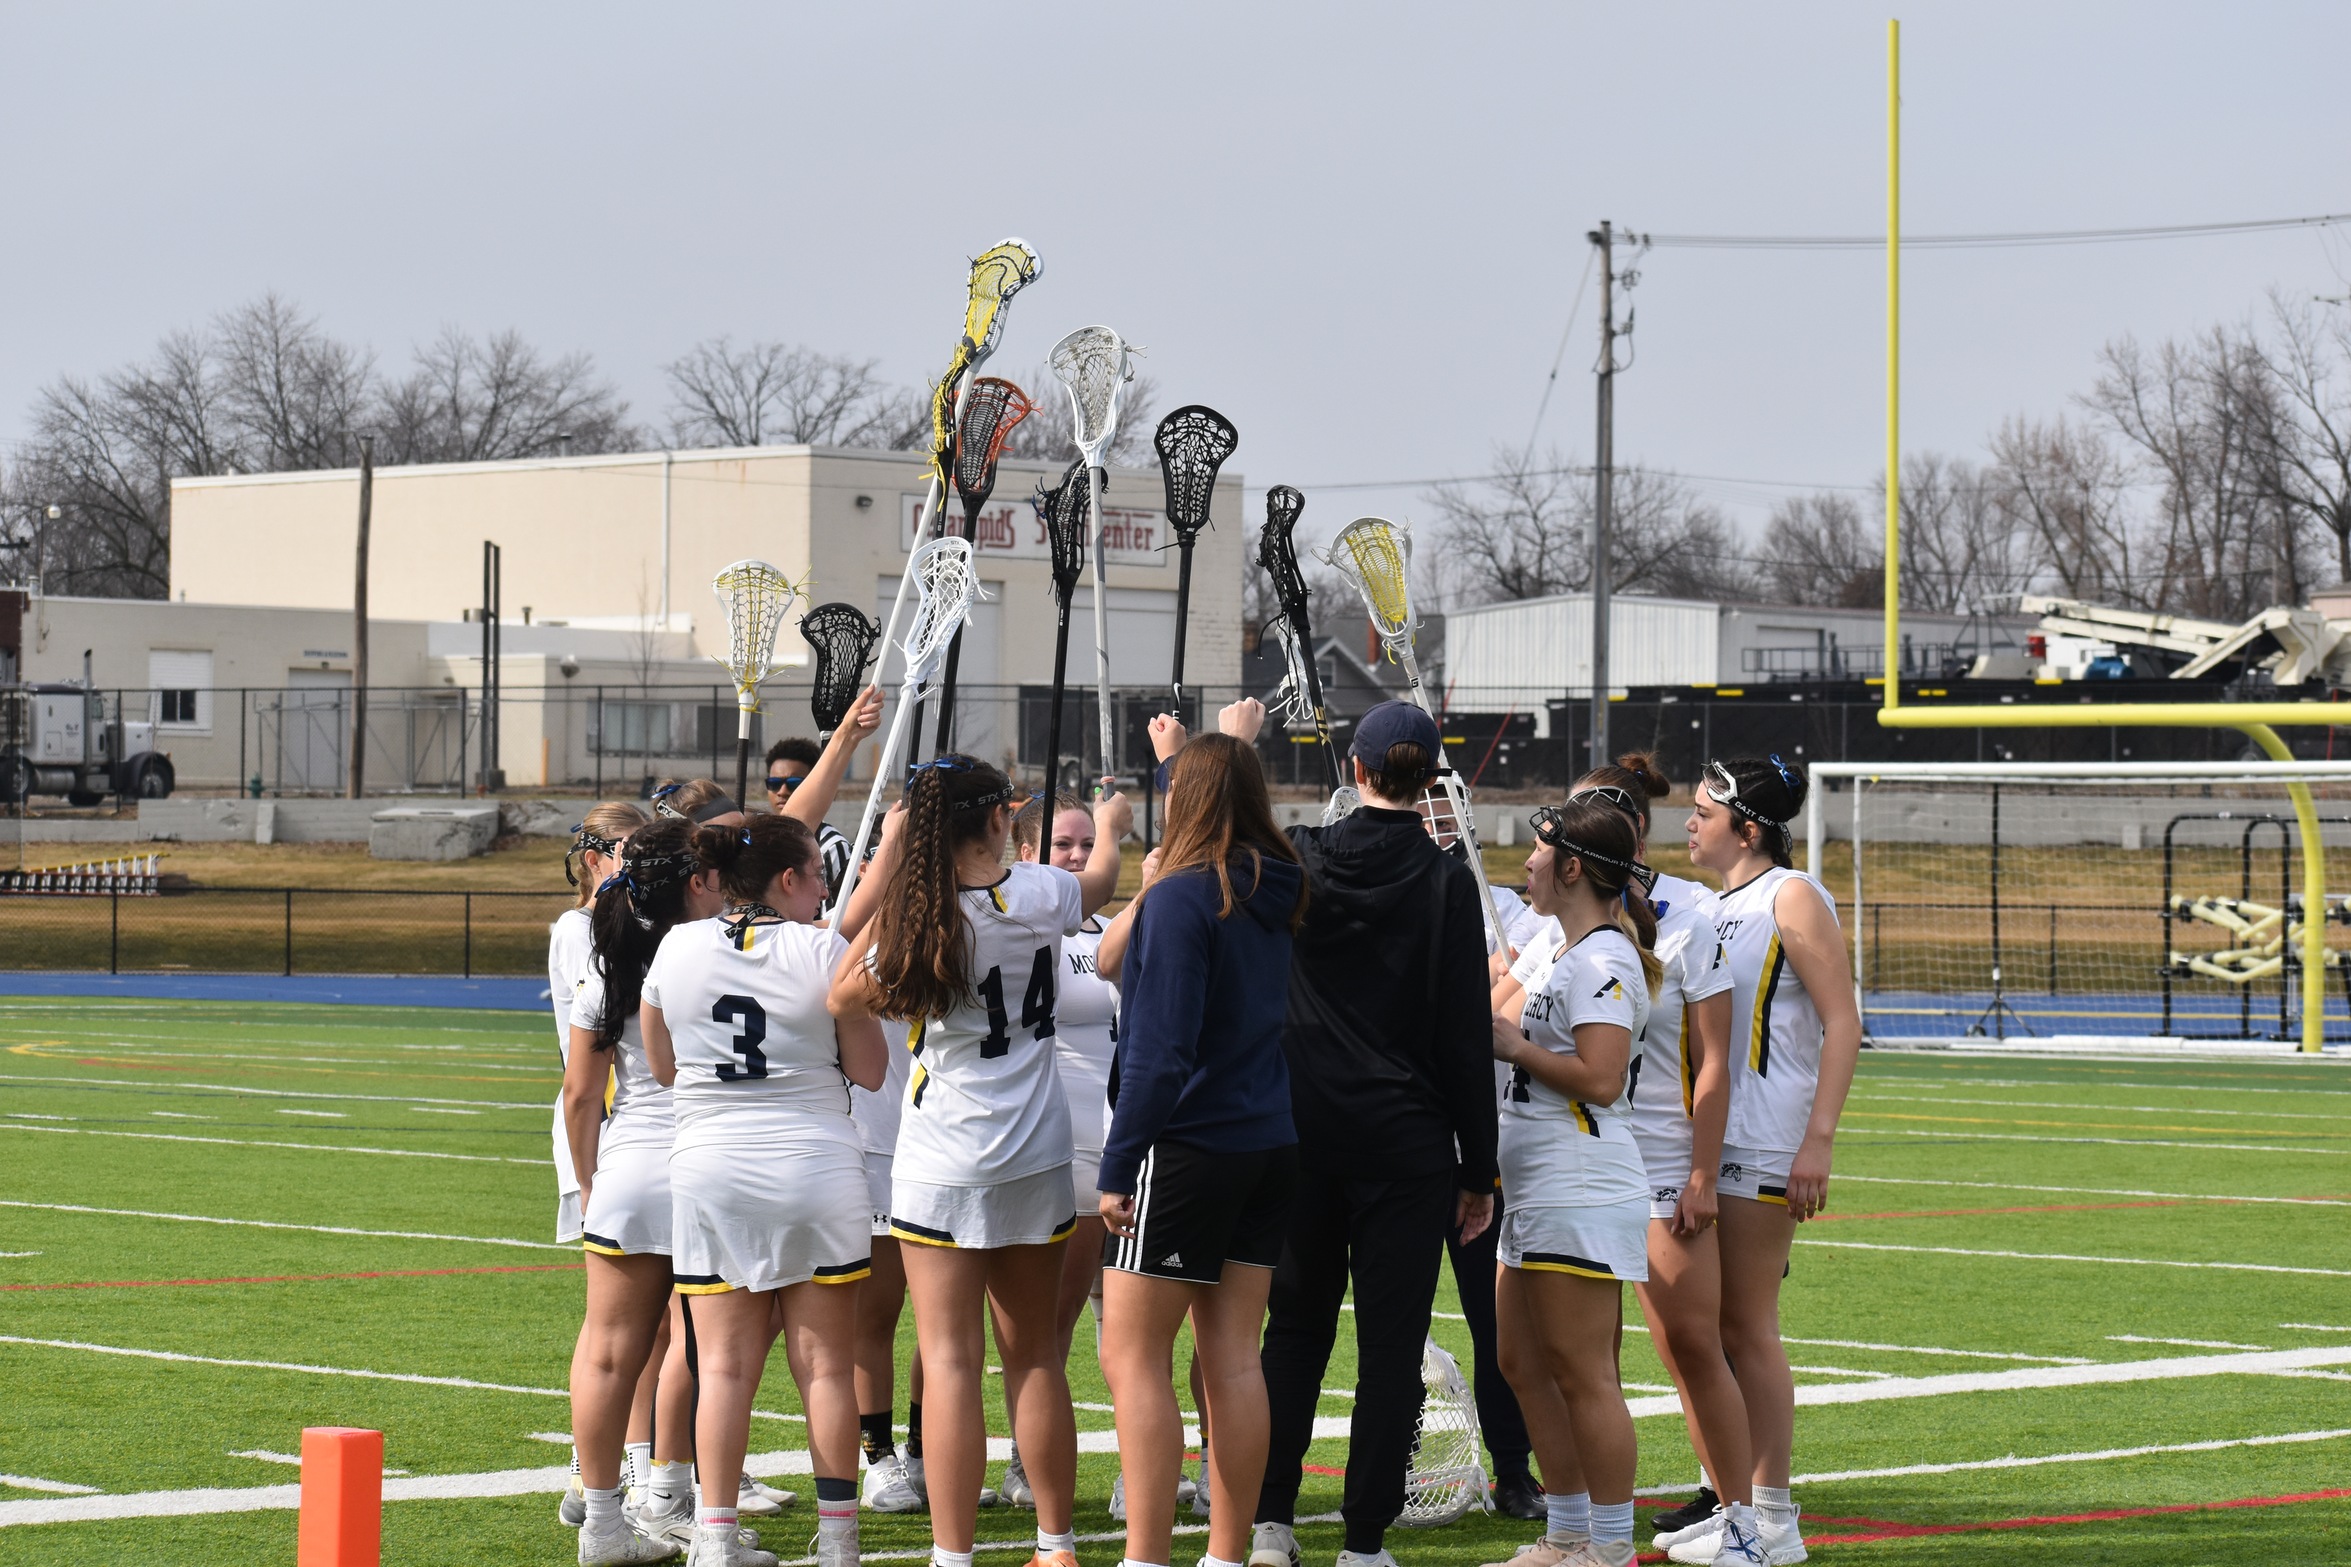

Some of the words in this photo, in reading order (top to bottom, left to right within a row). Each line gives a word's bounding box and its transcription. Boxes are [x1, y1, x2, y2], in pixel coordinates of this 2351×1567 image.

[978, 793, 999, 805] STX
[1735, 801, 1757, 817] GAIT
[1561, 839, 1582, 852] NDER
[1584, 850, 1619, 865] ARMOUR
[641, 857, 672, 867] STX
[977, 944, 1055, 1059] 14
[712, 994, 768, 1081] 3
[1161, 1260, 1183, 1268] adidas
